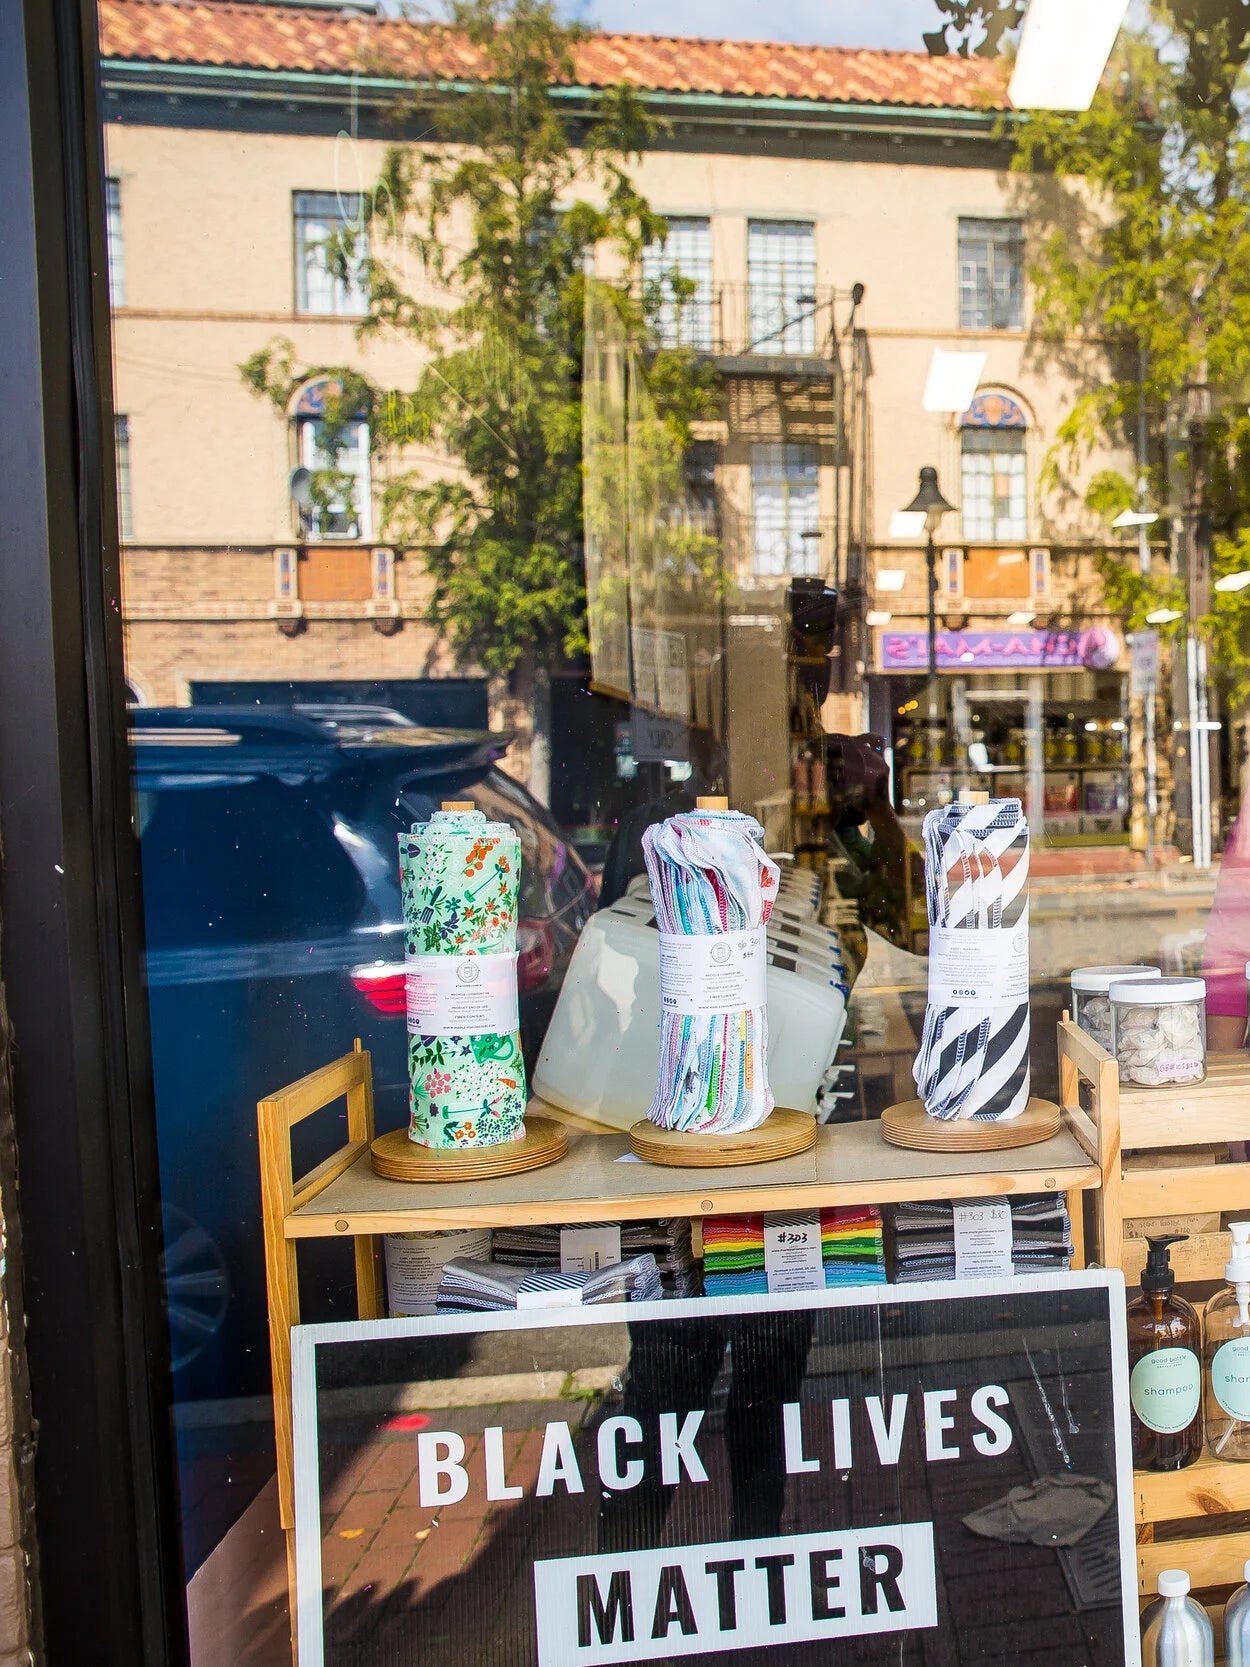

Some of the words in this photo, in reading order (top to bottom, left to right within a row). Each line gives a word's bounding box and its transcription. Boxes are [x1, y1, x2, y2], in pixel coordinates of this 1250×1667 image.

[958, 1211, 984, 1223] #303
[777, 1231, 808, 1245] #303
[1151, 1357, 1168, 1365] good
[1169, 1355, 1187, 1363] bottle
[1144, 1383, 1194, 1396] shampoo
[417, 1410, 709, 1509] BLACK
[783, 1384, 1013, 1475] LIVES
[576, 1543, 907, 1650] MATTER
